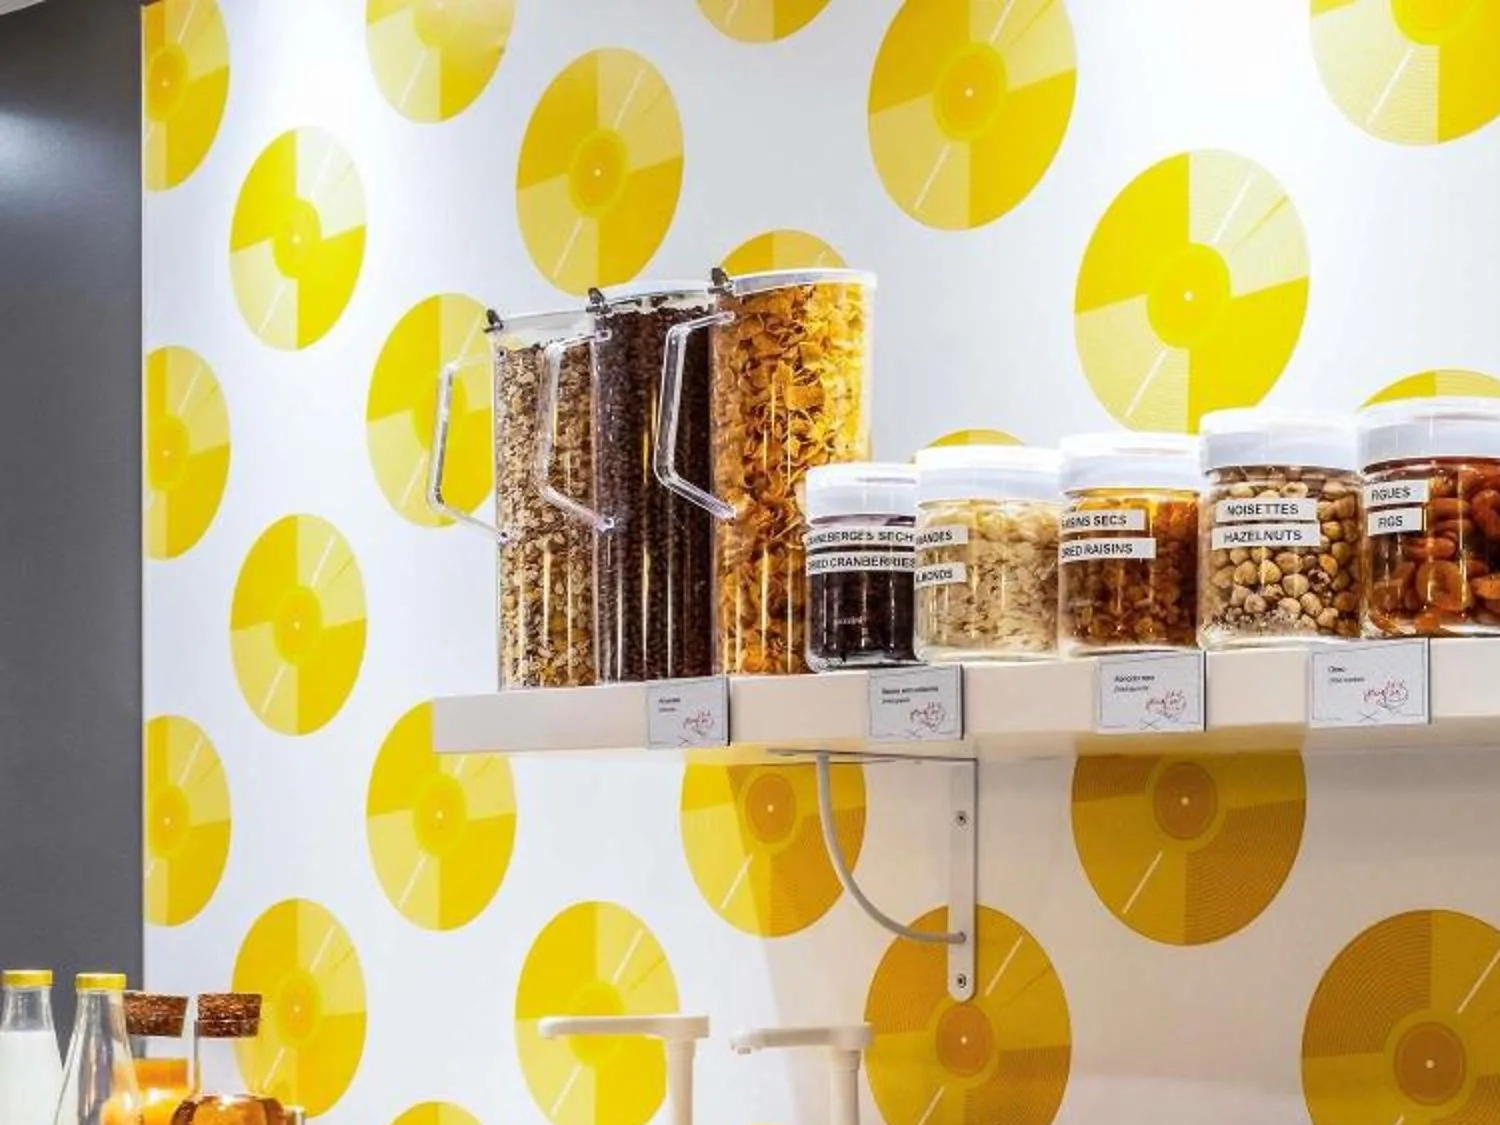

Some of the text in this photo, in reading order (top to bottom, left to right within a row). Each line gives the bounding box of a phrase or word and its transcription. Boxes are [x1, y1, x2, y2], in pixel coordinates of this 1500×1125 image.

[1371, 485, 1412, 501] FIGUES
[1226, 502, 1299, 516] NOISETTES
[1093, 514, 1127, 527] SECS
[1378, 514, 1404, 529] FIGS
[1223, 528, 1303, 544] HAZELNUTS
[1083, 543, 1133, 556] RAISINS
